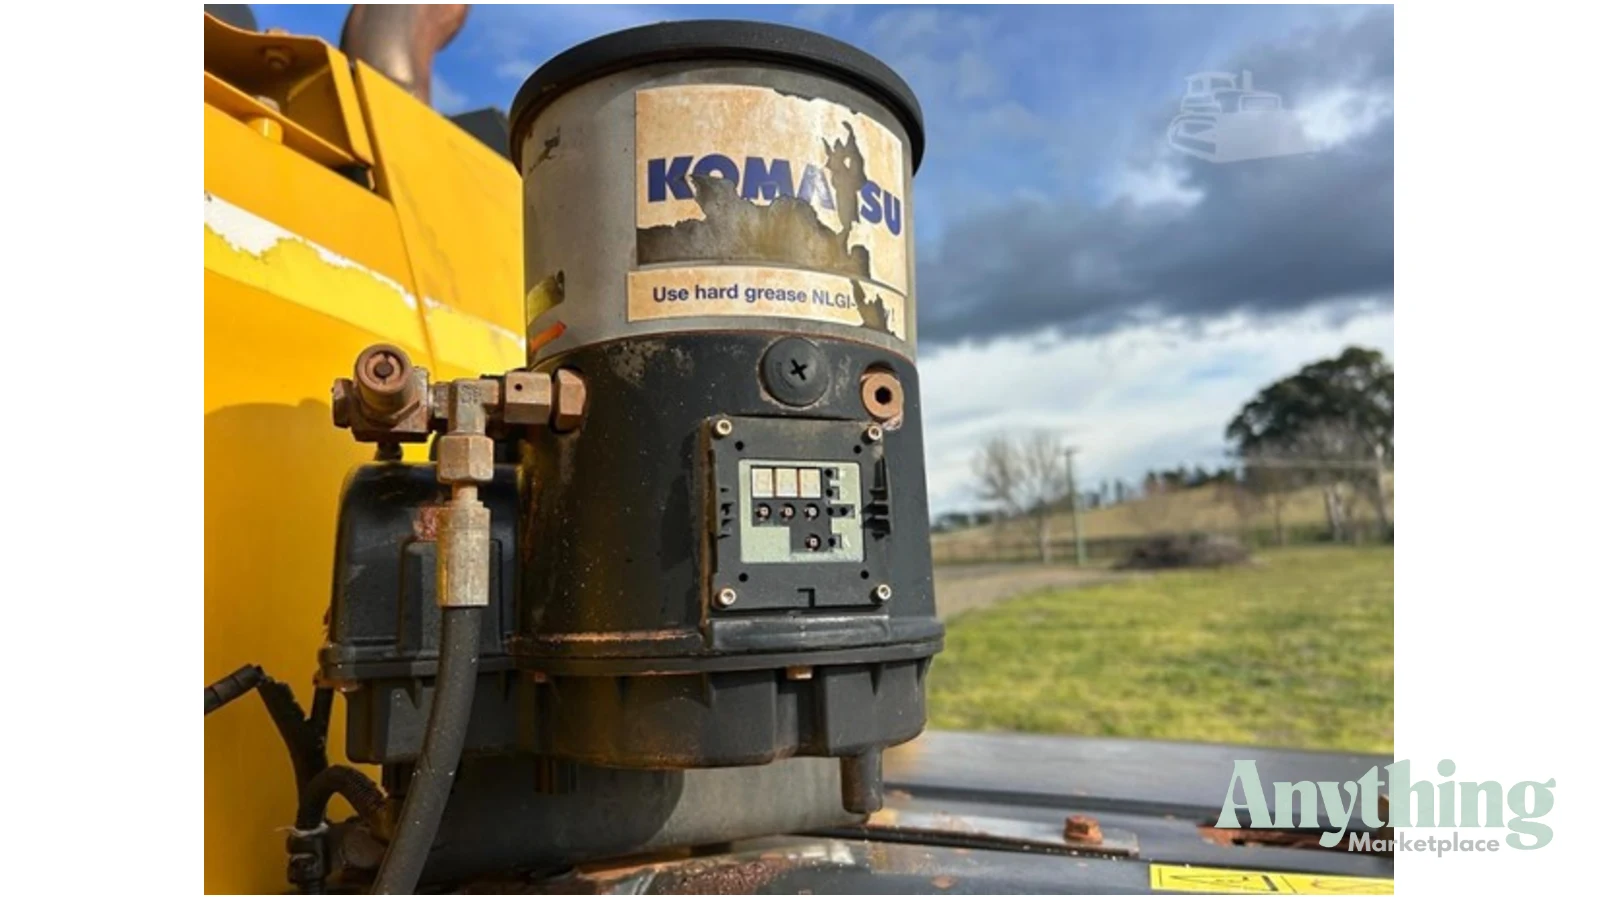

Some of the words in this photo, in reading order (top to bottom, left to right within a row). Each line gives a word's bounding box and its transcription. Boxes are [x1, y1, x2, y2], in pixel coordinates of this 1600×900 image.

[648, 154, 901, 236] KOMASU
[653, 286, 689, 303] Use
[695, 284, 739, 301] hard
[744, 287, 807, 304] grease
[812, 289, 857, 310] NLGI-
